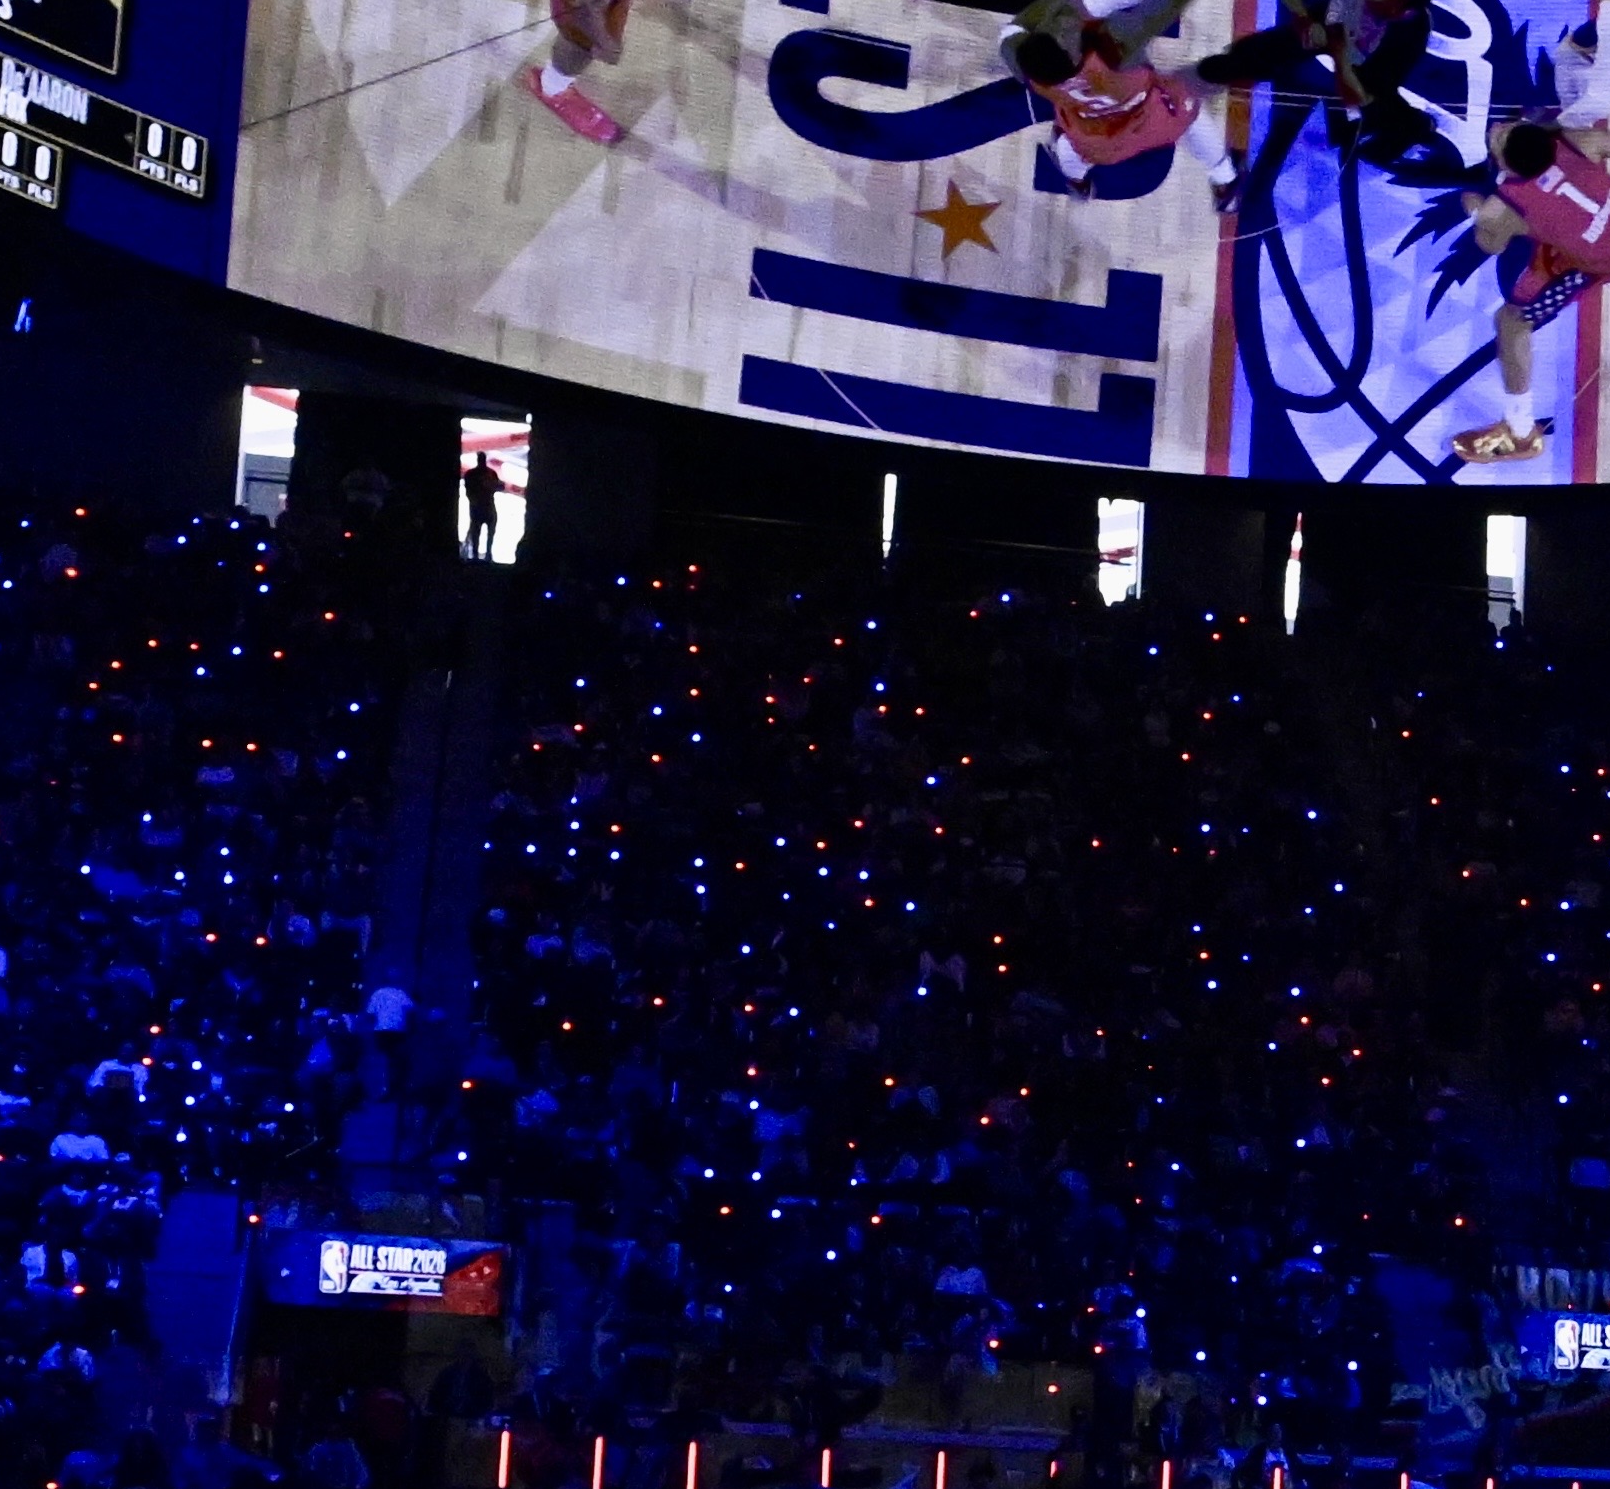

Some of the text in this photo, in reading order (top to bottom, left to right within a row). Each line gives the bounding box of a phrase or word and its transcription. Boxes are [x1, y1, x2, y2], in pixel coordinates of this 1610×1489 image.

[351, 1245, 374, 1269] ALL
[377, 1246, 413, 1271] STAR
[1581, 1323, 1602, 1347] ALL
